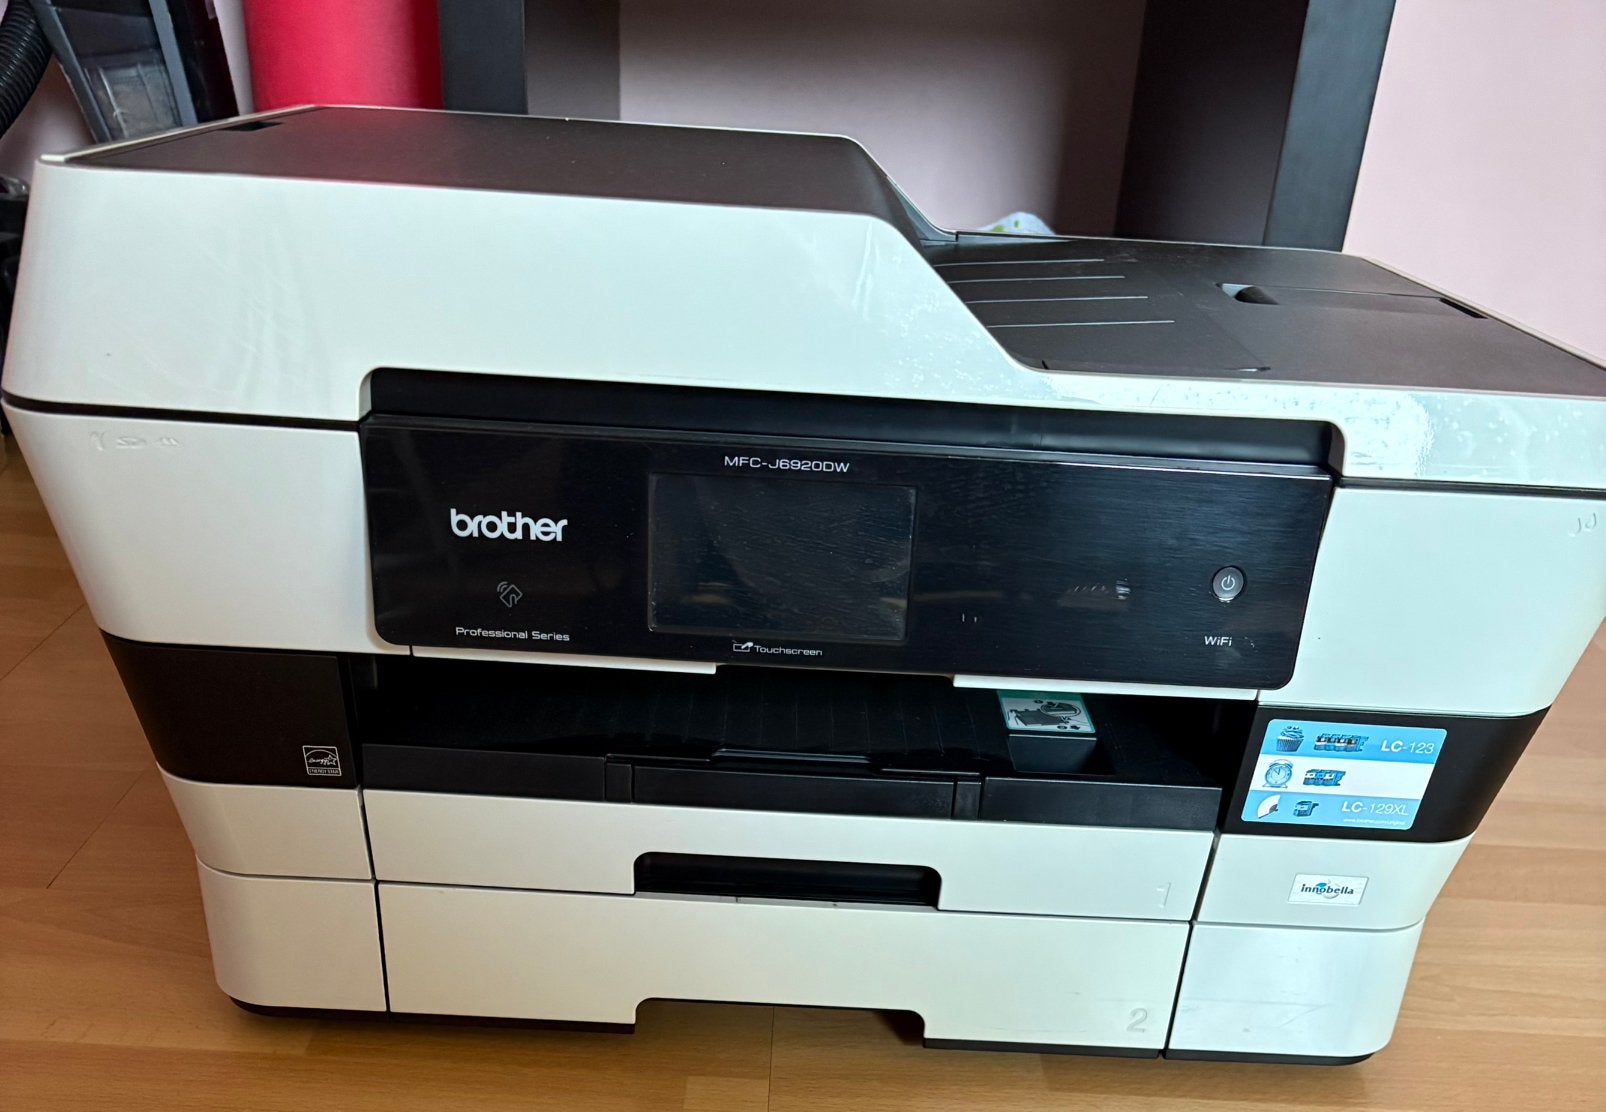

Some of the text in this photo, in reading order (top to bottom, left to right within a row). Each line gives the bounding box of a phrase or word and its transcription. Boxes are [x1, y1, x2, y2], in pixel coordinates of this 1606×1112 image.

[724, 455, 850, 473] MFC-J6920DW
[449, 507, 568, 542] brother
[455, 626, 570, 641] Professional Series
[1204, 635, 1233, 647] WiFi
[753, 644, 823, 656] Touchscreen
[1380, 739, 1435, 755] LC-123
[1341, 800, 1409, 816] LC-129XL
[1300, 883, 1354, 895] innobella
[1126, 1007, 1148, 1033] 2
